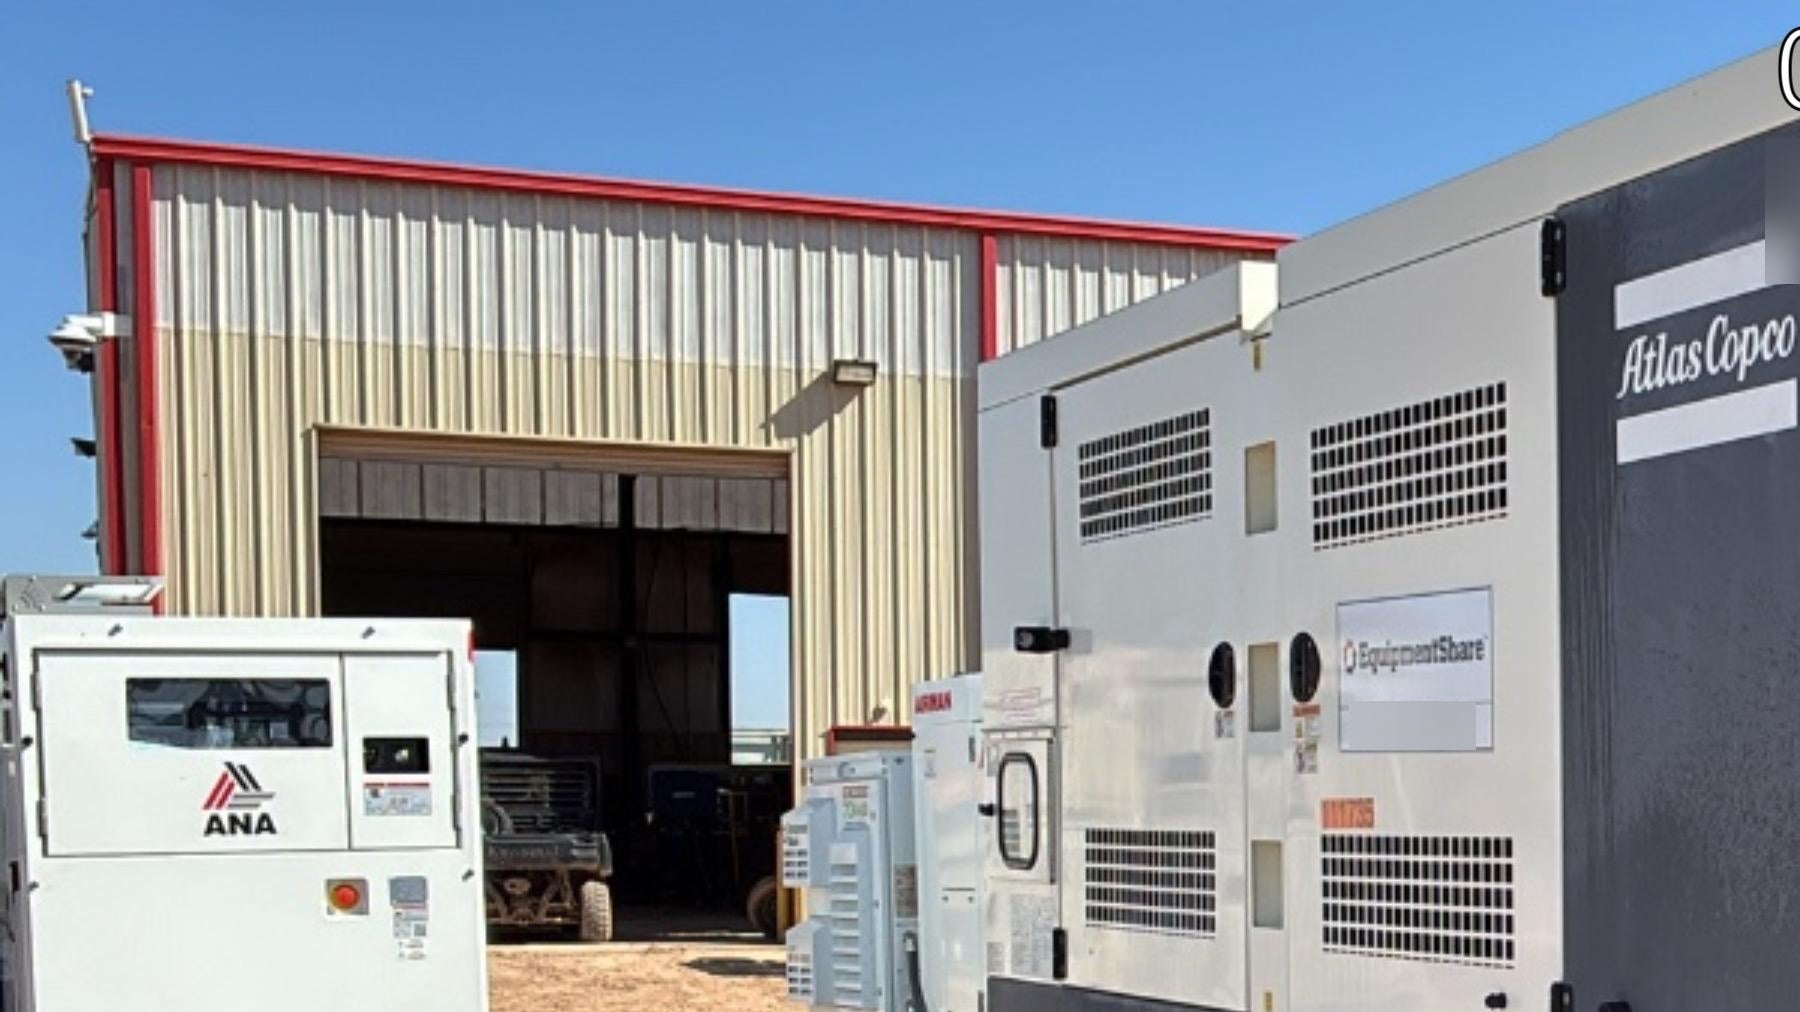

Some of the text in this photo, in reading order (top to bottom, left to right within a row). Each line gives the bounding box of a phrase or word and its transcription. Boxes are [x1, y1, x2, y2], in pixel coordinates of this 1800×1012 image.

[1616, 313, 1796, 399] Atlas Copco
[203, 813, 277, 836] ANA
